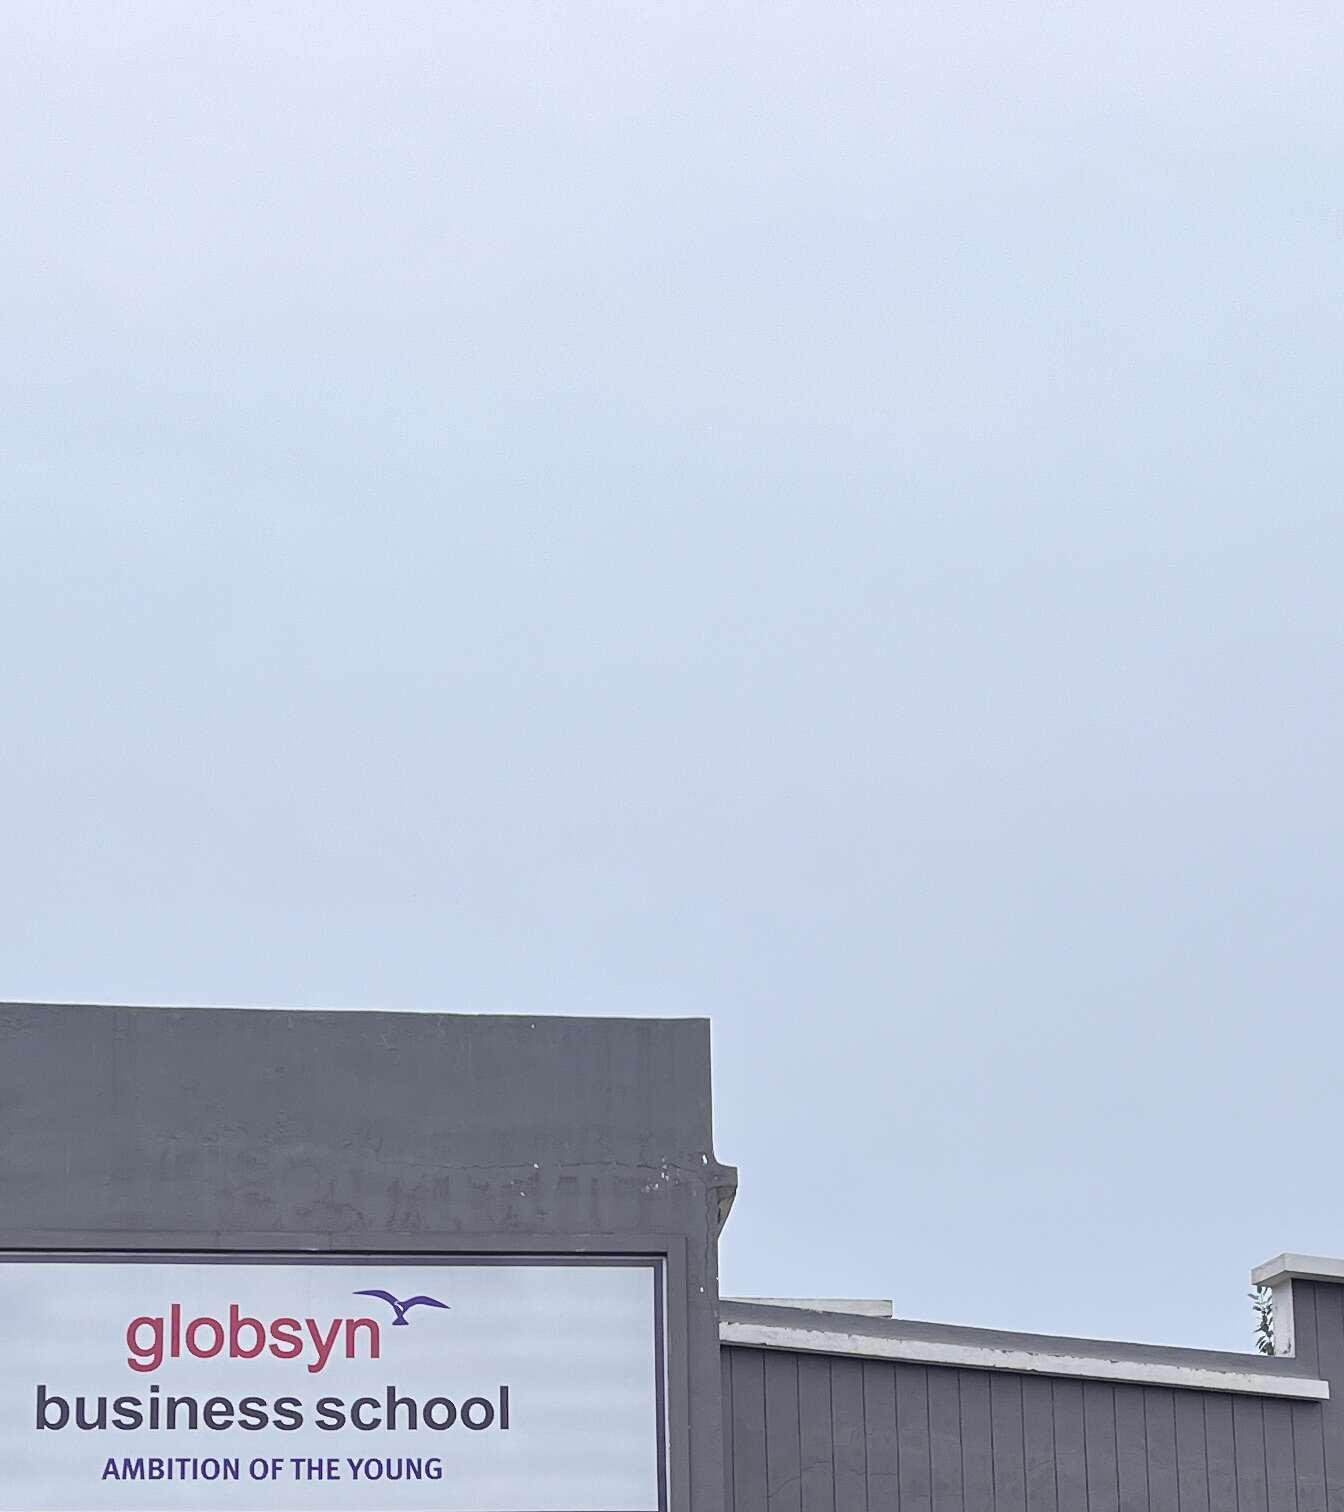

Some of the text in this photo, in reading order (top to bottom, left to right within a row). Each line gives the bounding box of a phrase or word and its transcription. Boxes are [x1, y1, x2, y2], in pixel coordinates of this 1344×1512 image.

[127, 1304, 381, 1373] globsyn
[36, 1385, 509, 1430] business school
[102, 1458, 442, 1480] AMBITION OF THE YOUNG
